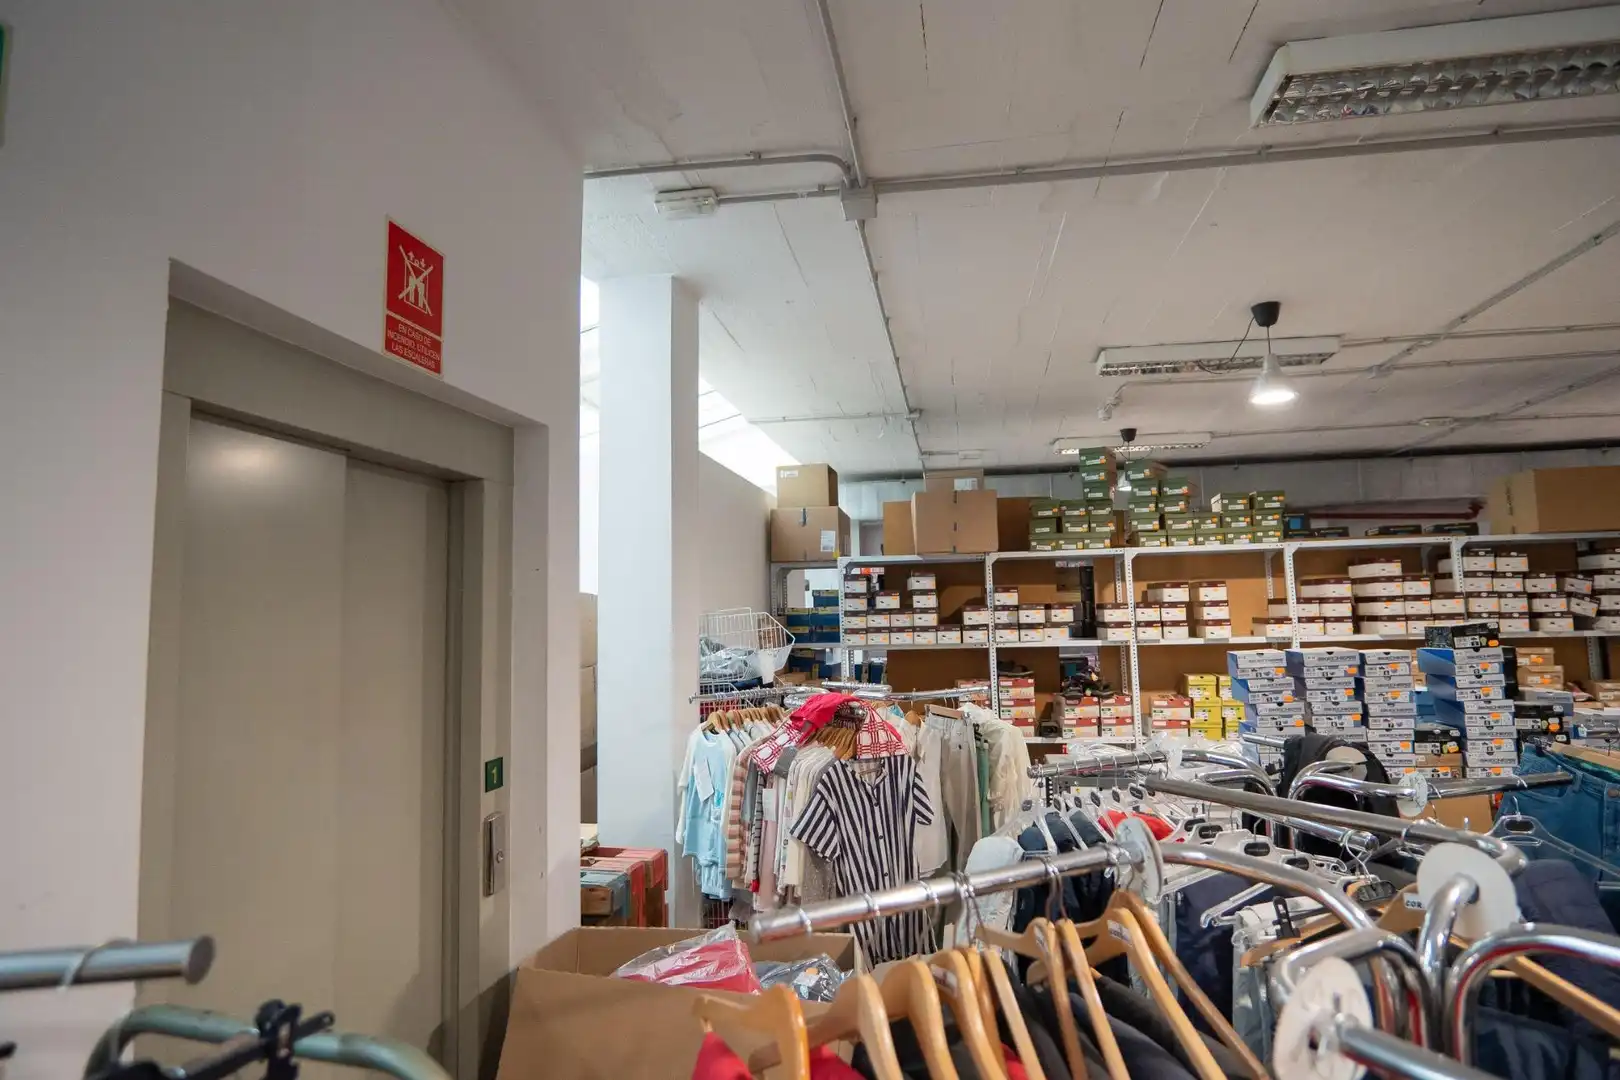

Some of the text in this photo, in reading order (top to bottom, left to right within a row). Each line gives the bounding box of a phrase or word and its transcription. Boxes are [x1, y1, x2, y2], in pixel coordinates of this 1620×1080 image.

[399, 323, 432, 347] EN CASO DE
[391, 341, 436, 369] LAS ESCALERAS
[491, 766, 498, 784] 1
